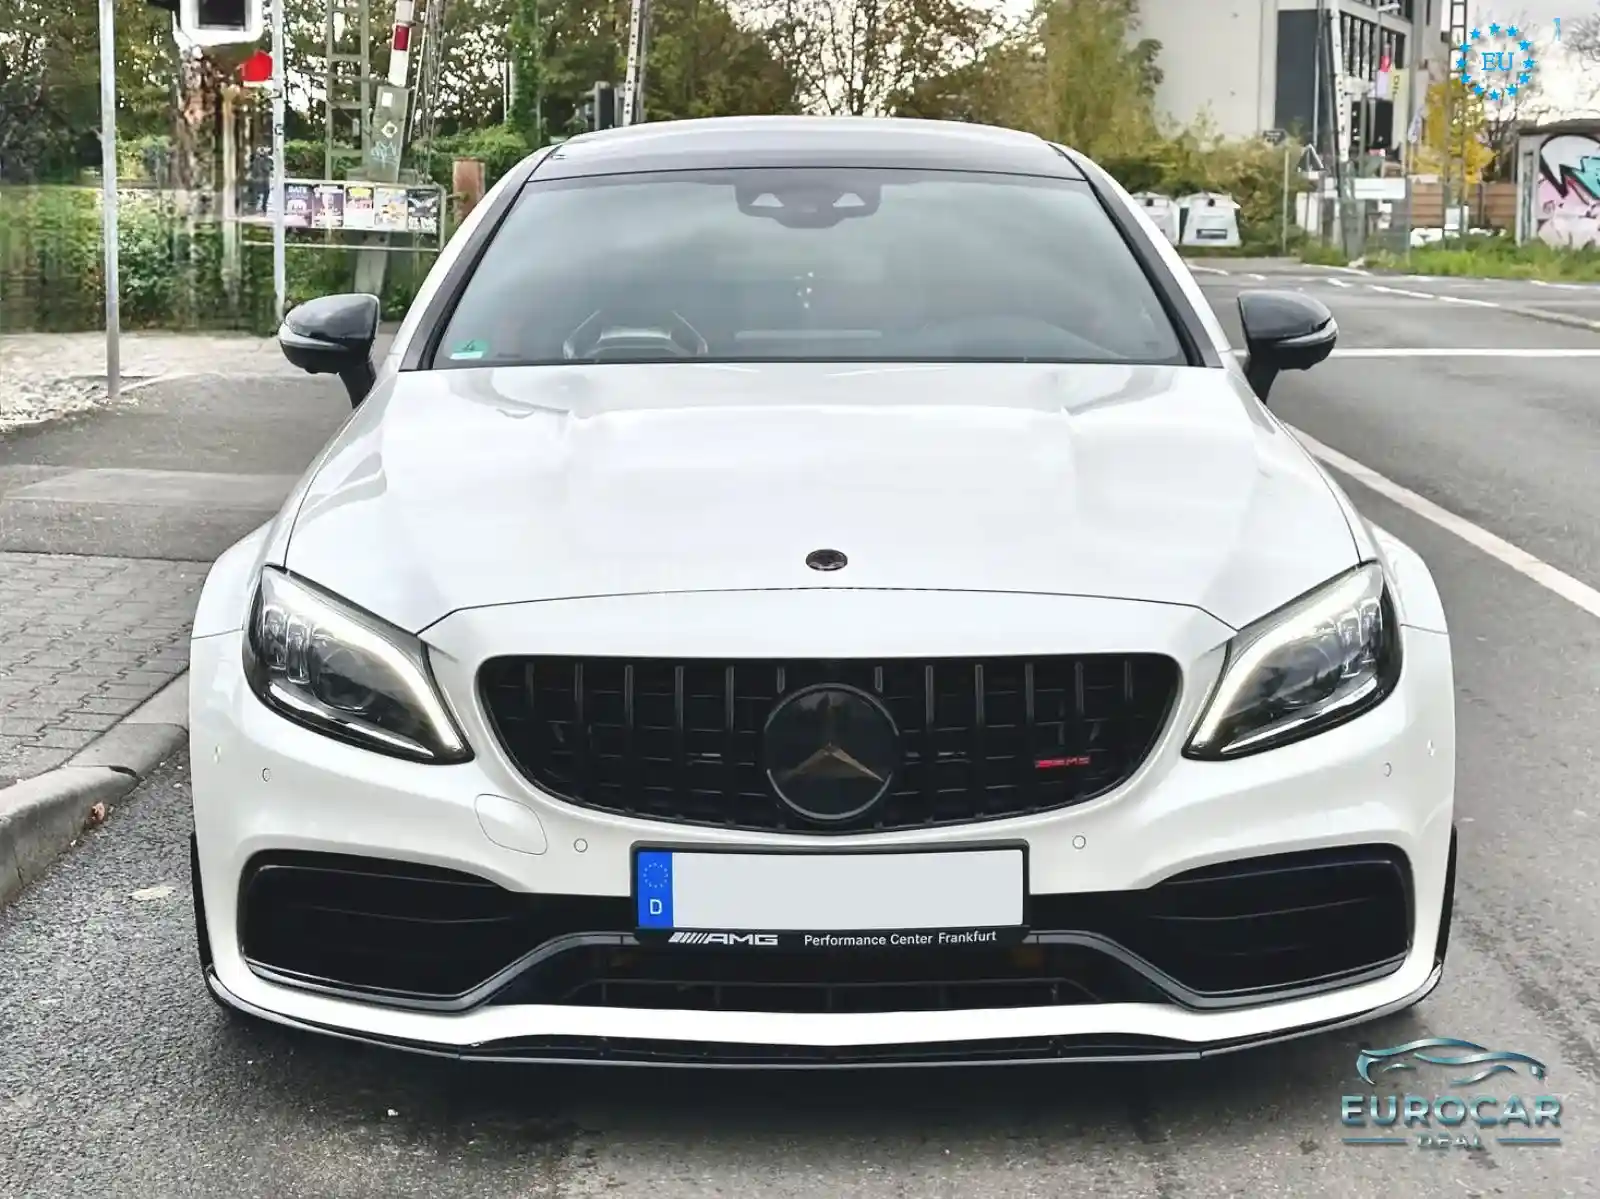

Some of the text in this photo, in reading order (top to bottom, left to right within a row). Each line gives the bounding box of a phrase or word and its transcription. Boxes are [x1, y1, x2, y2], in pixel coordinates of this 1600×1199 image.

[650, 899, 662, 914] D
[804, 934, 887, 947] Performance
[890, 933, 933, 945] Center
[938, 930, 997, 944] Frankfurt
